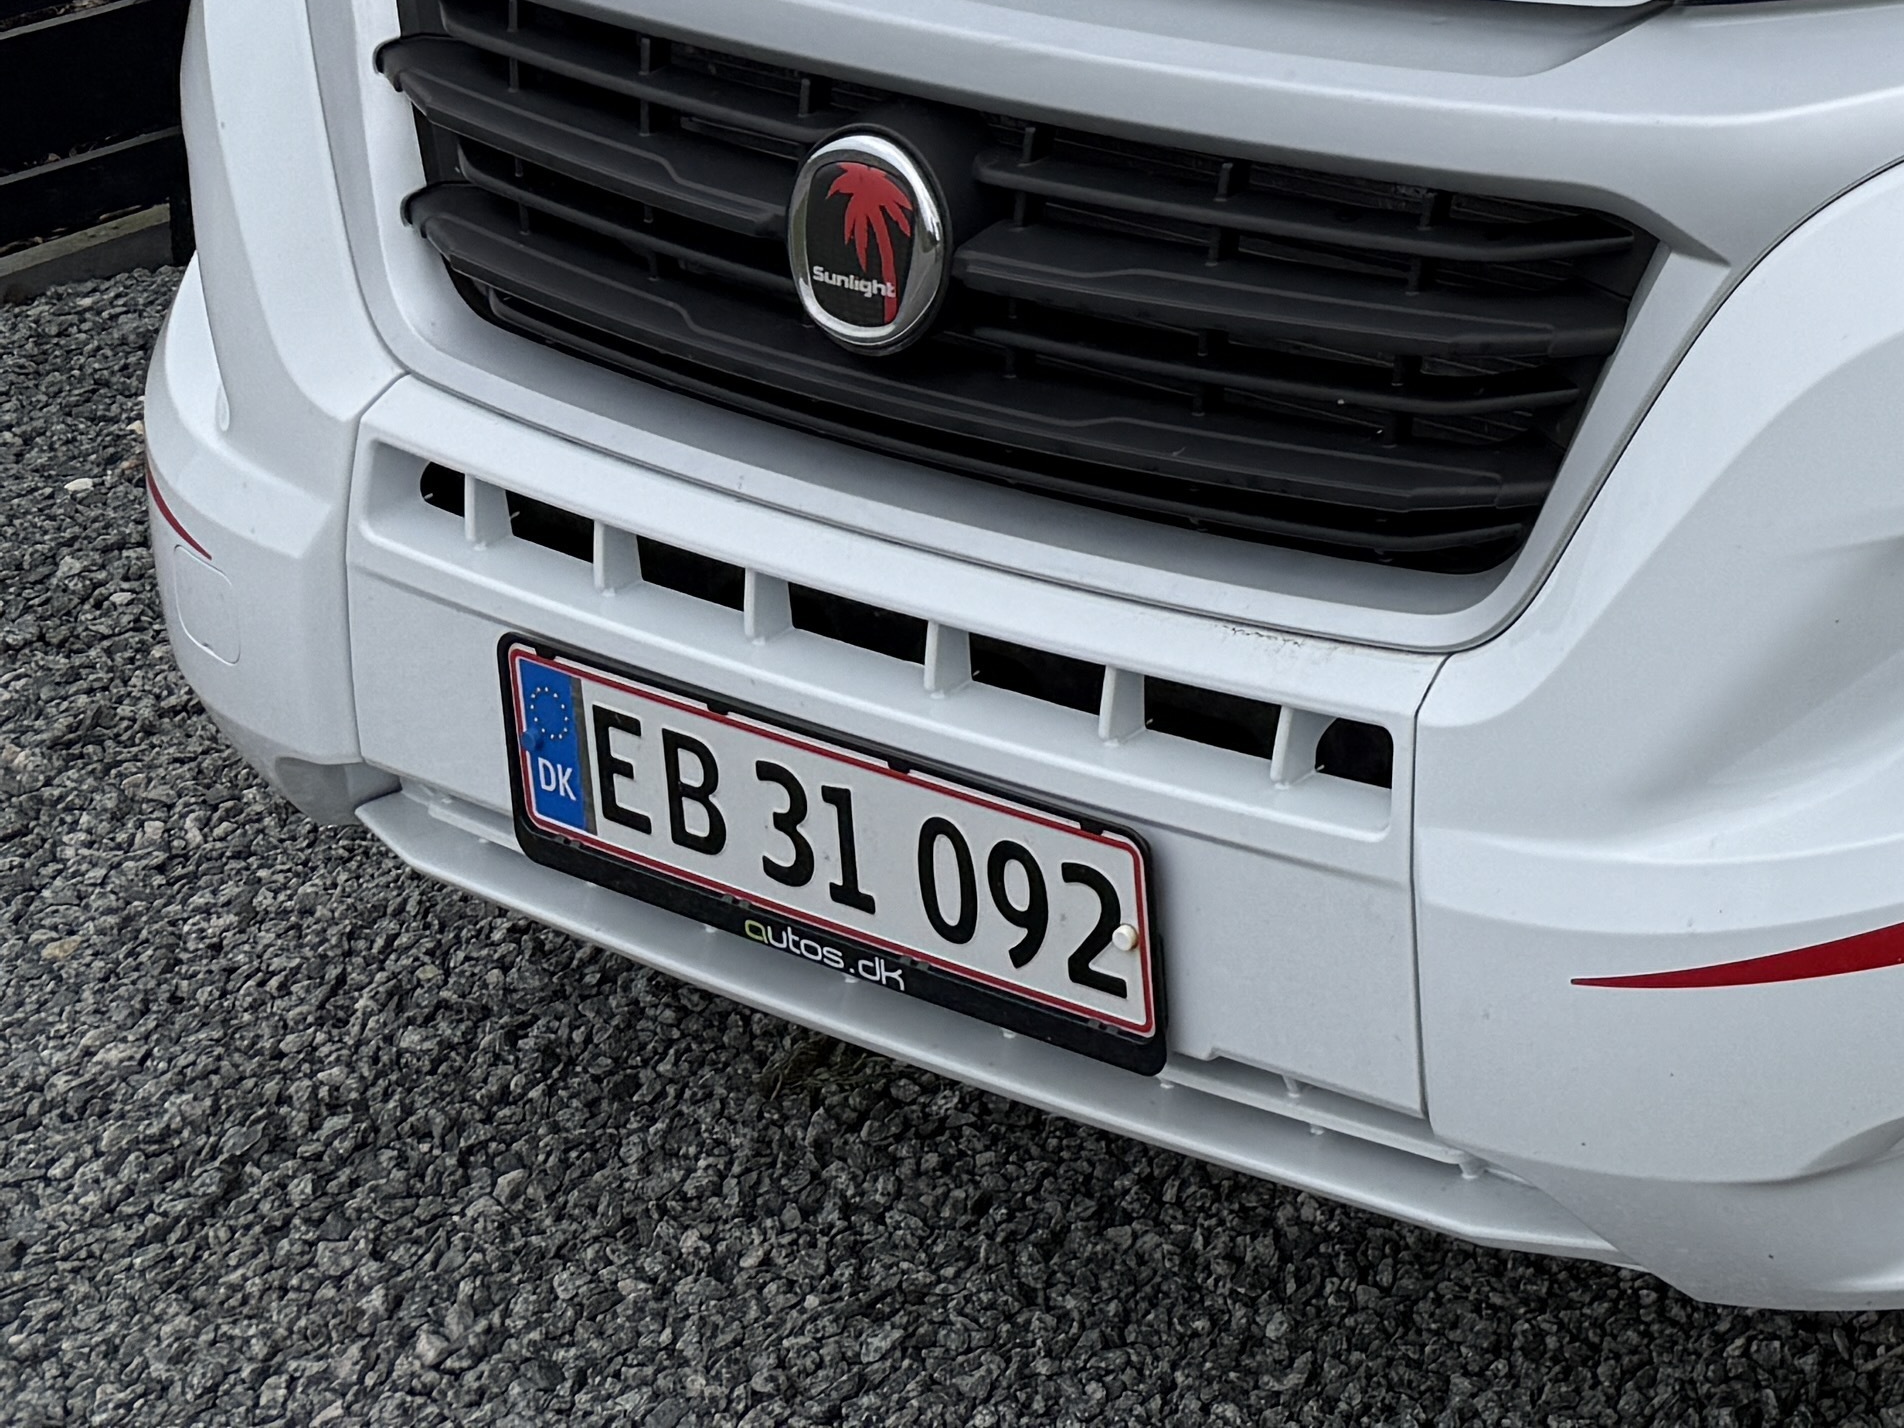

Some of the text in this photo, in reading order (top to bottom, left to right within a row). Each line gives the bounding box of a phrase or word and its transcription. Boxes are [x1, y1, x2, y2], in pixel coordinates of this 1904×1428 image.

[812, 265, 896, 298] Sunlight
[538, 757, 577, 803] DK
[592, 703, 1129, 1000] EB 31 092
[744, 918, 906, 992] autos.dk
